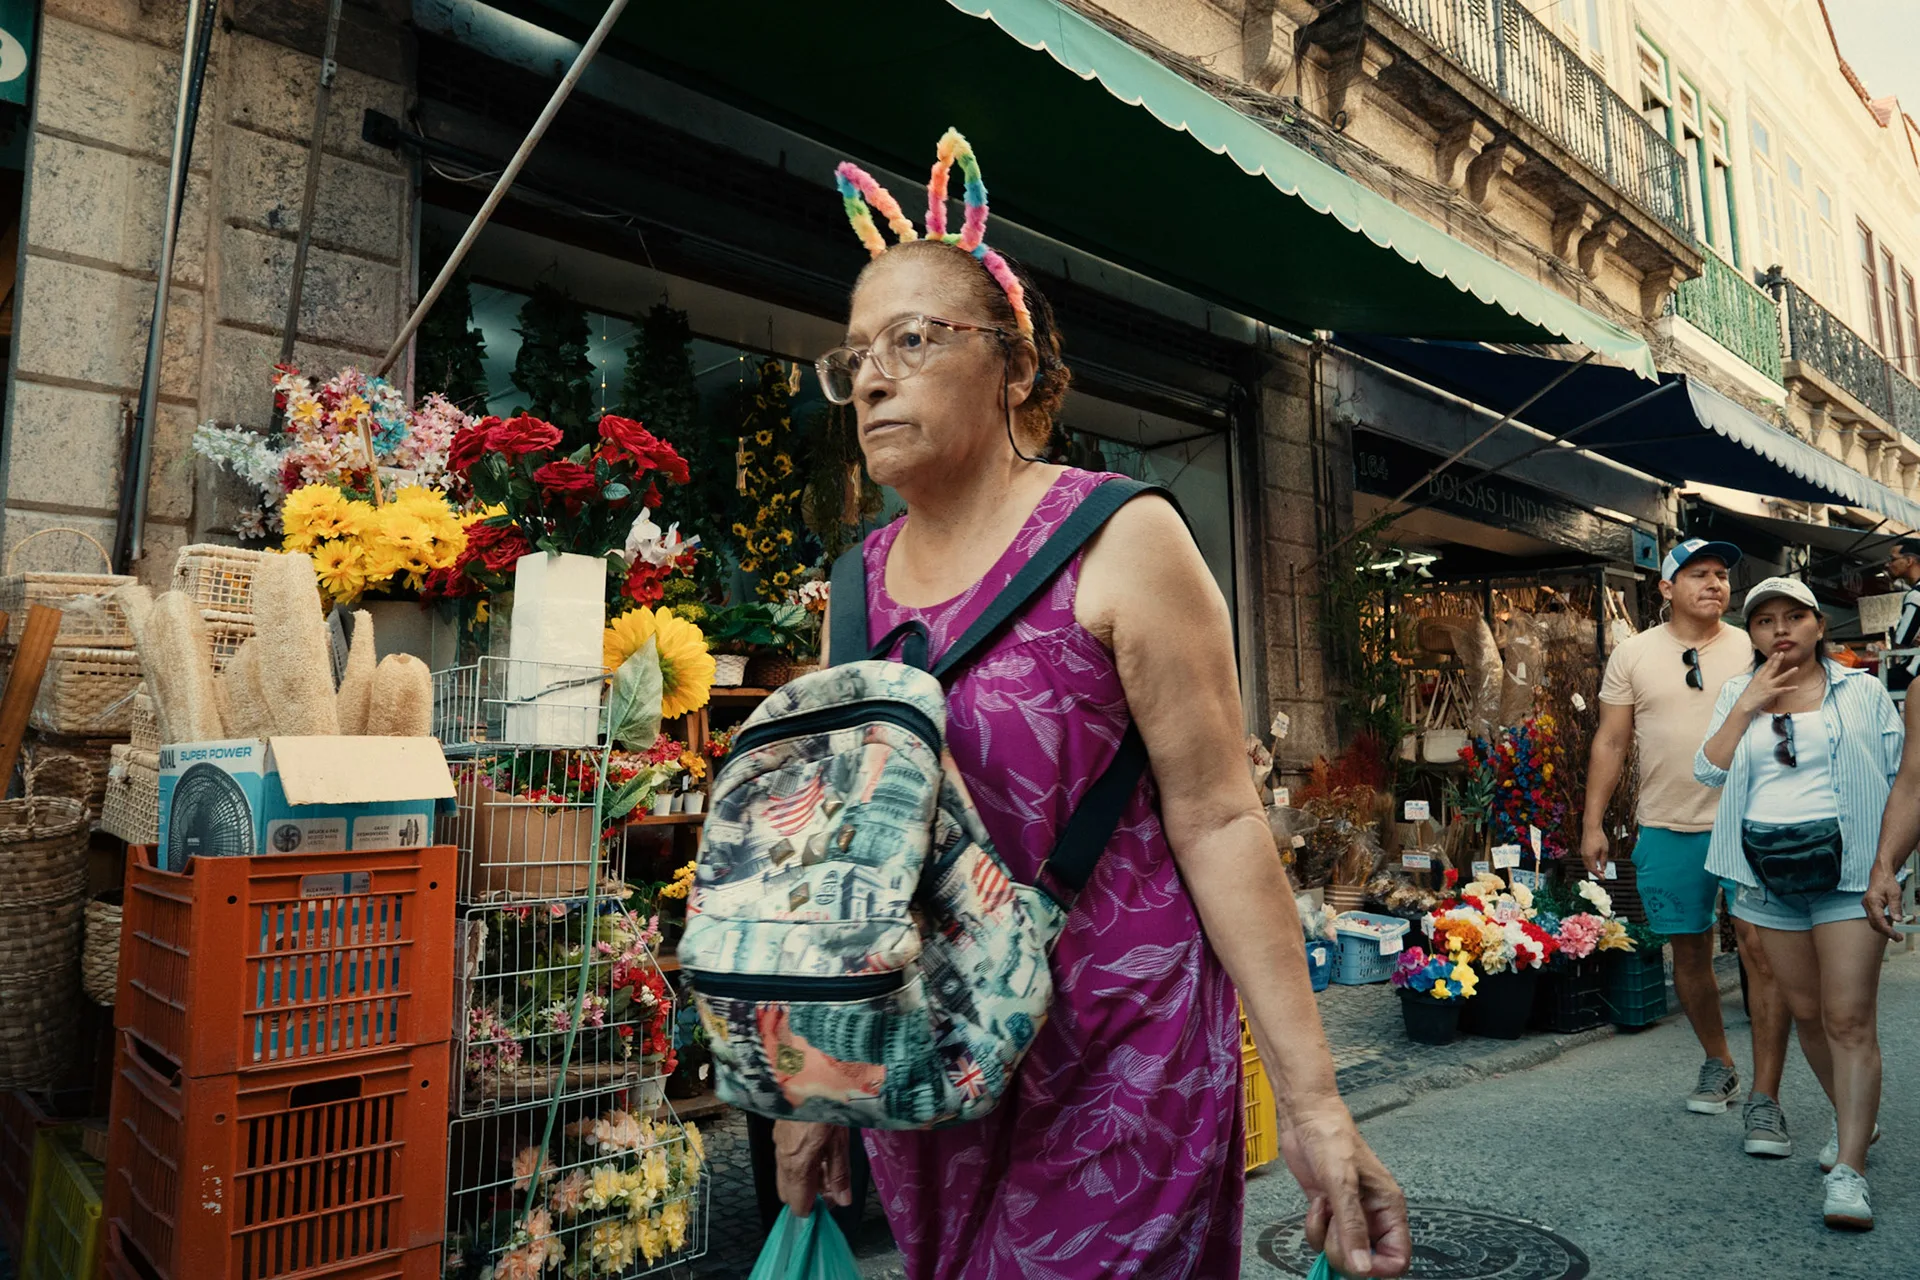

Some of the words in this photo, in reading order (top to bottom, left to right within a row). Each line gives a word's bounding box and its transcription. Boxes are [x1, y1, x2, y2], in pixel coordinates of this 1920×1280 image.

[1428, 469, 1497, 514] BOLSAS
[1501, 491, 1555, 526] LINDAS
[180, 749, 207, 761] SUPER
[208, 746, 252, 759] POWER
